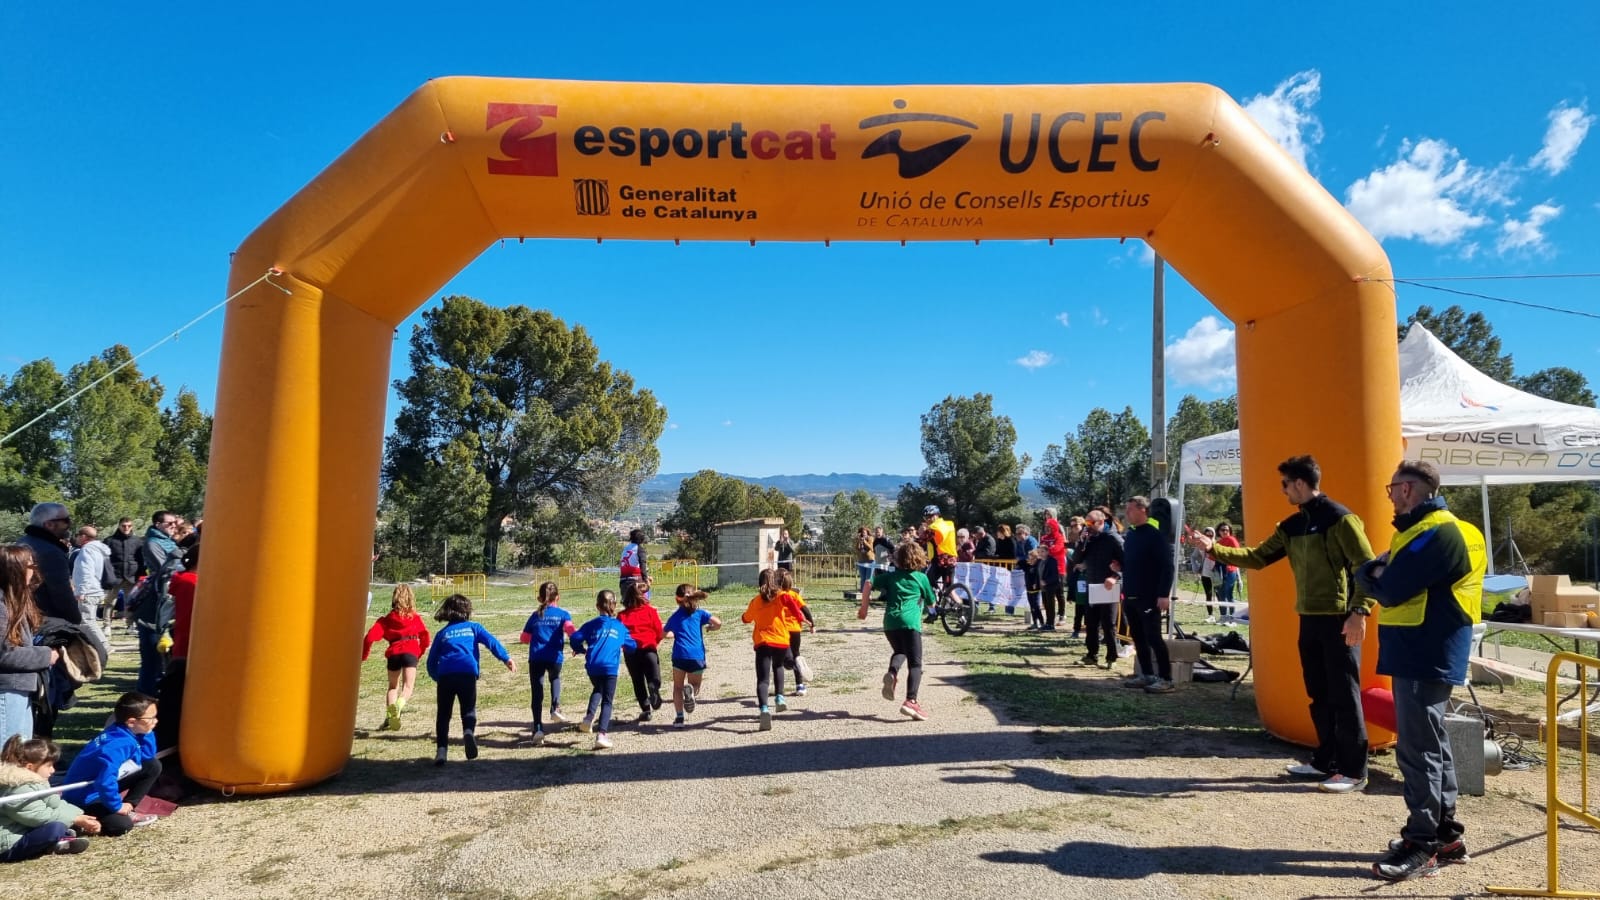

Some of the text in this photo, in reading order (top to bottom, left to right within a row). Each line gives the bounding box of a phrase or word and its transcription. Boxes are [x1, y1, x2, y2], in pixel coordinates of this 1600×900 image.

[573, 122, 837, 167] esportcat
[999, 111, 1167, 175] UCEC
[618, 184, 737, 204] Generalitat
[859, 189, 1151, 213] Unió de Consells Esportius
[621, 205, 758, 223] de Catalunya
[856, 213, 984, 228] DE CATALUNYA
[1425, 431, 1548, 446] CONSELL
[1419, 447, 1550, 467] RIBERA
